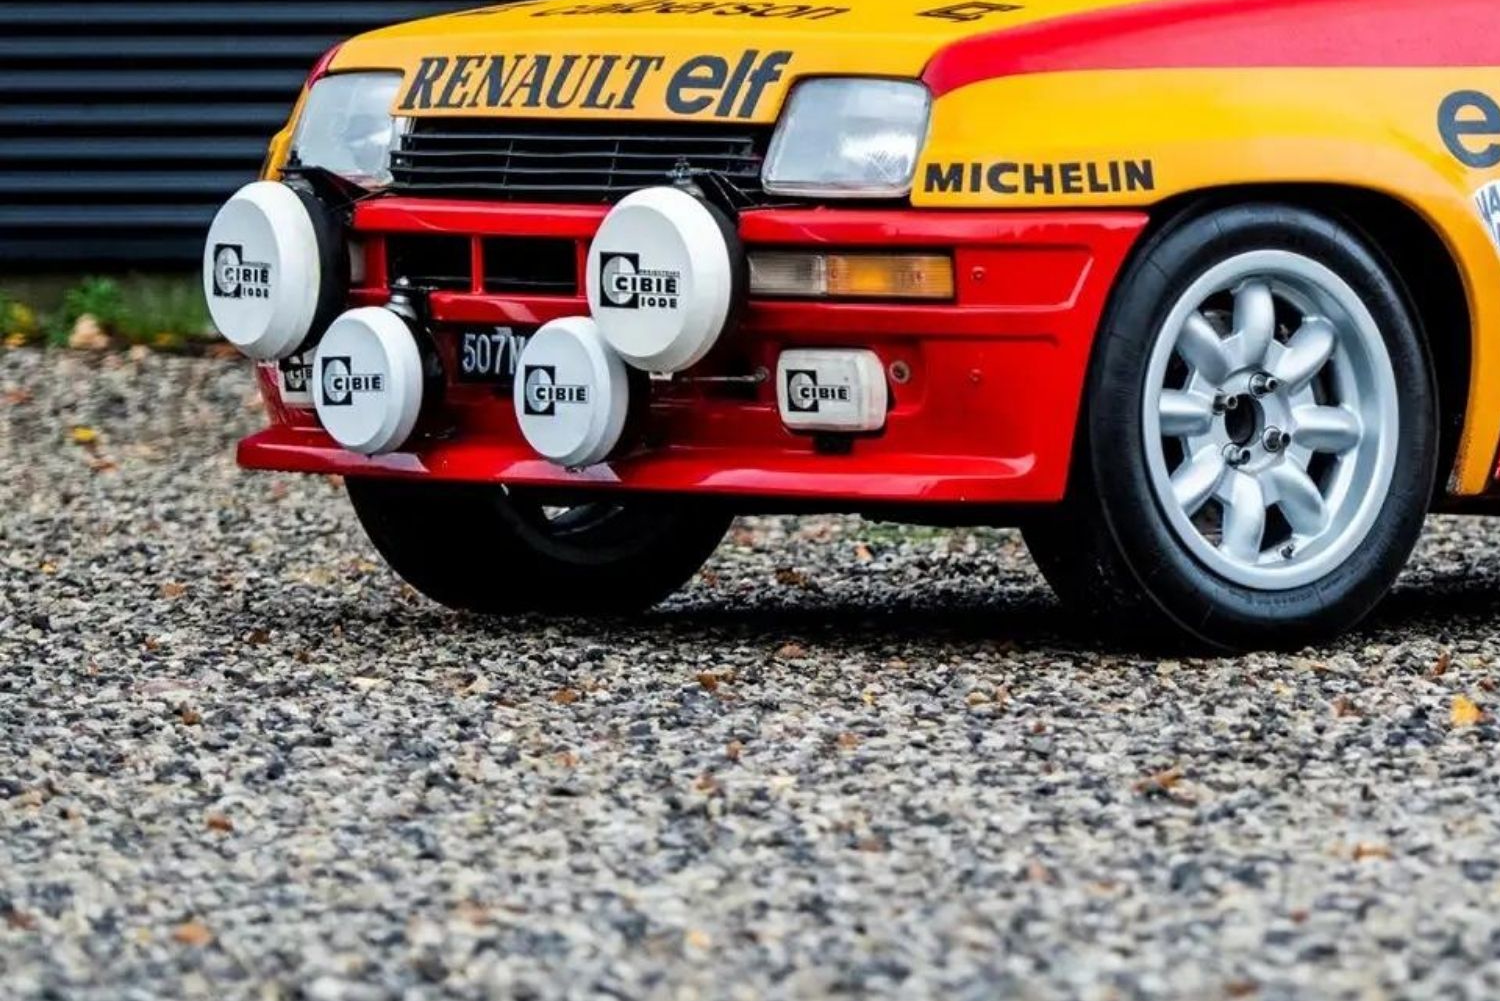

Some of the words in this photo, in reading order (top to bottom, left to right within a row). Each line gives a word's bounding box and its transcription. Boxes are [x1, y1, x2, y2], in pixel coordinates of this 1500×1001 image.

[397, 54, 665, 110] RENAULT
[665, 49, 794, 118] elf
[923, 160, 1155, 194] MICHELIN
[641, 297, 677, 308] IODE
